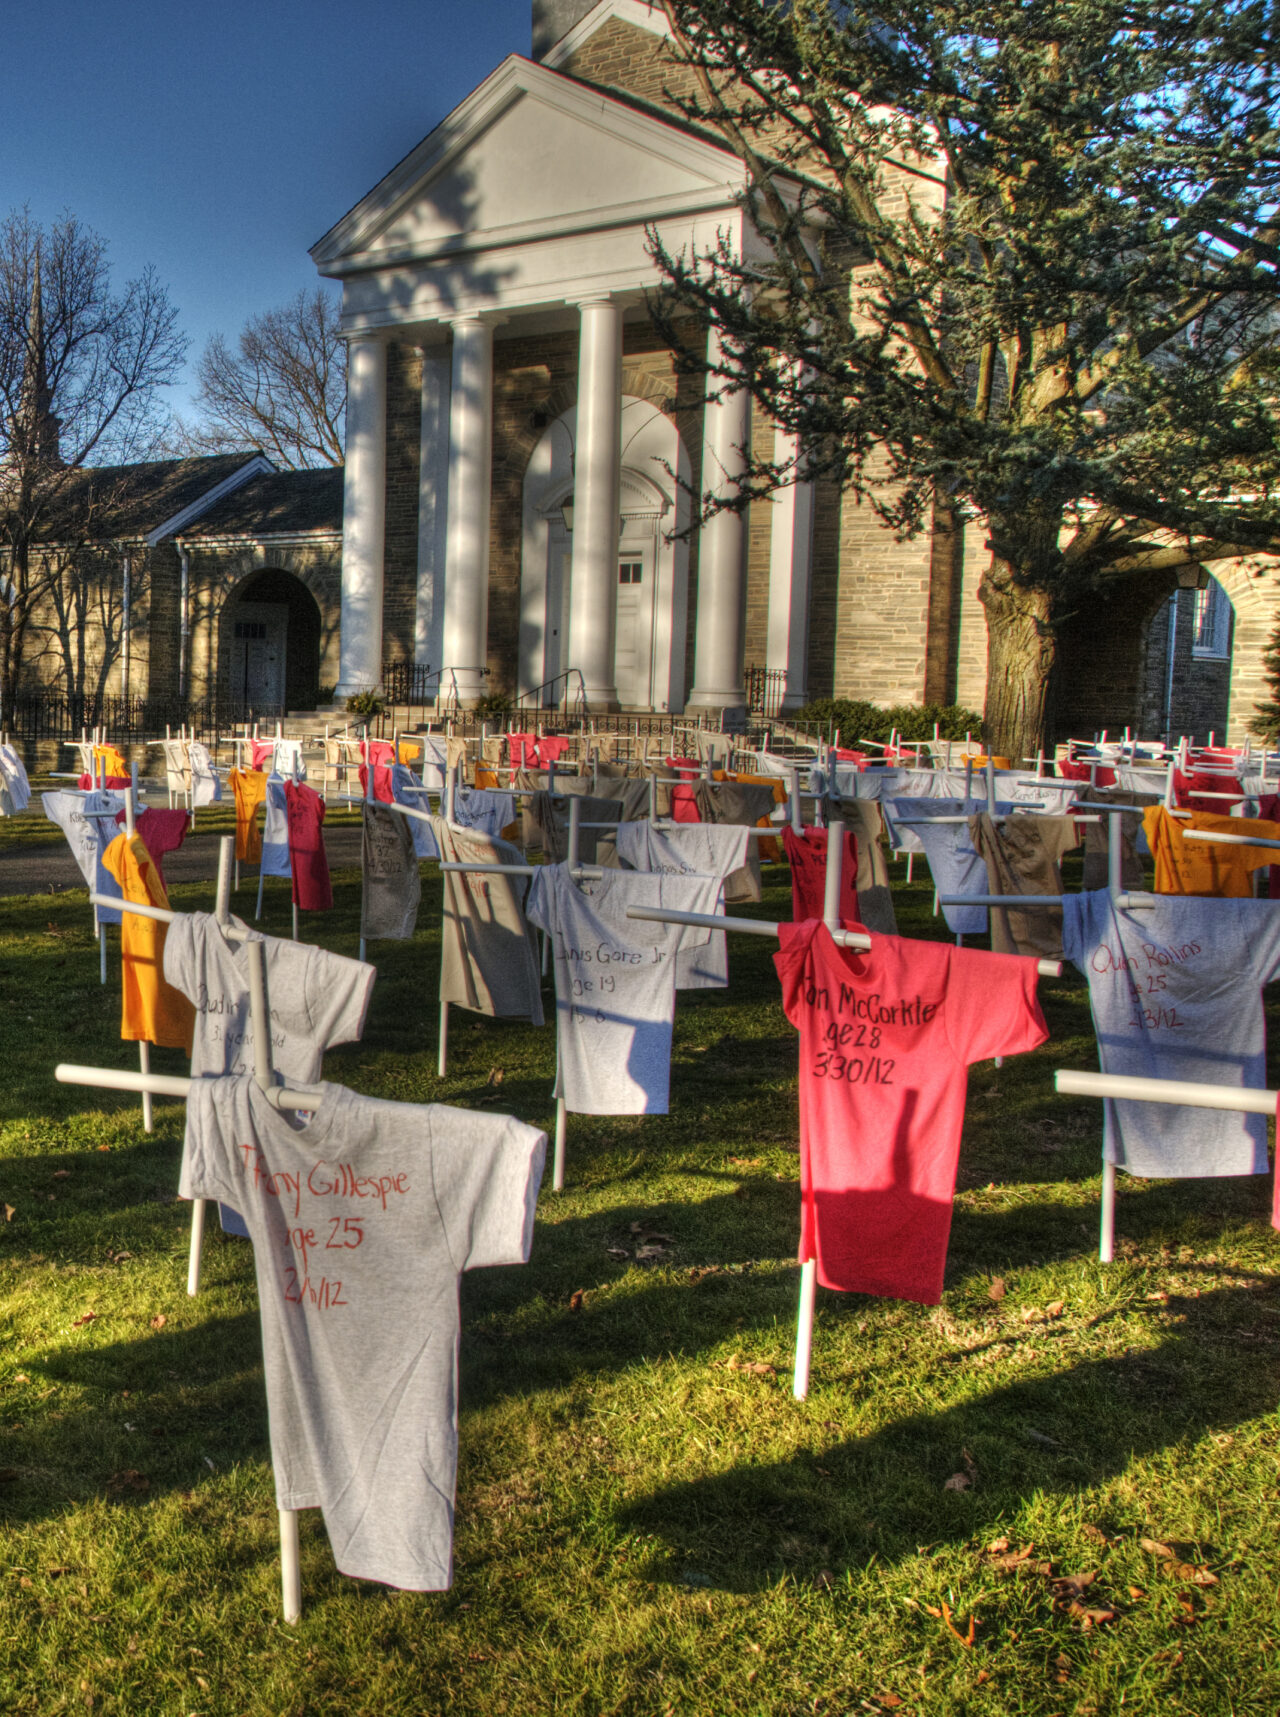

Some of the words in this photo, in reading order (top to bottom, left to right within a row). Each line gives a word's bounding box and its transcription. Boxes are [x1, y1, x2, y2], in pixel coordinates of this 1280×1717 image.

[596, 943, 642, 964] Gore
[651, 947, 667, 964] Jr
[1142, 940, 1202, 969] Rollins
[1147, 974, 1167, 993] 25
[838, 982, 937, 1027] McCorkle
[307, 1159, 411, 1212] Gillespie
[326, 1216, 366, 1250] 25
